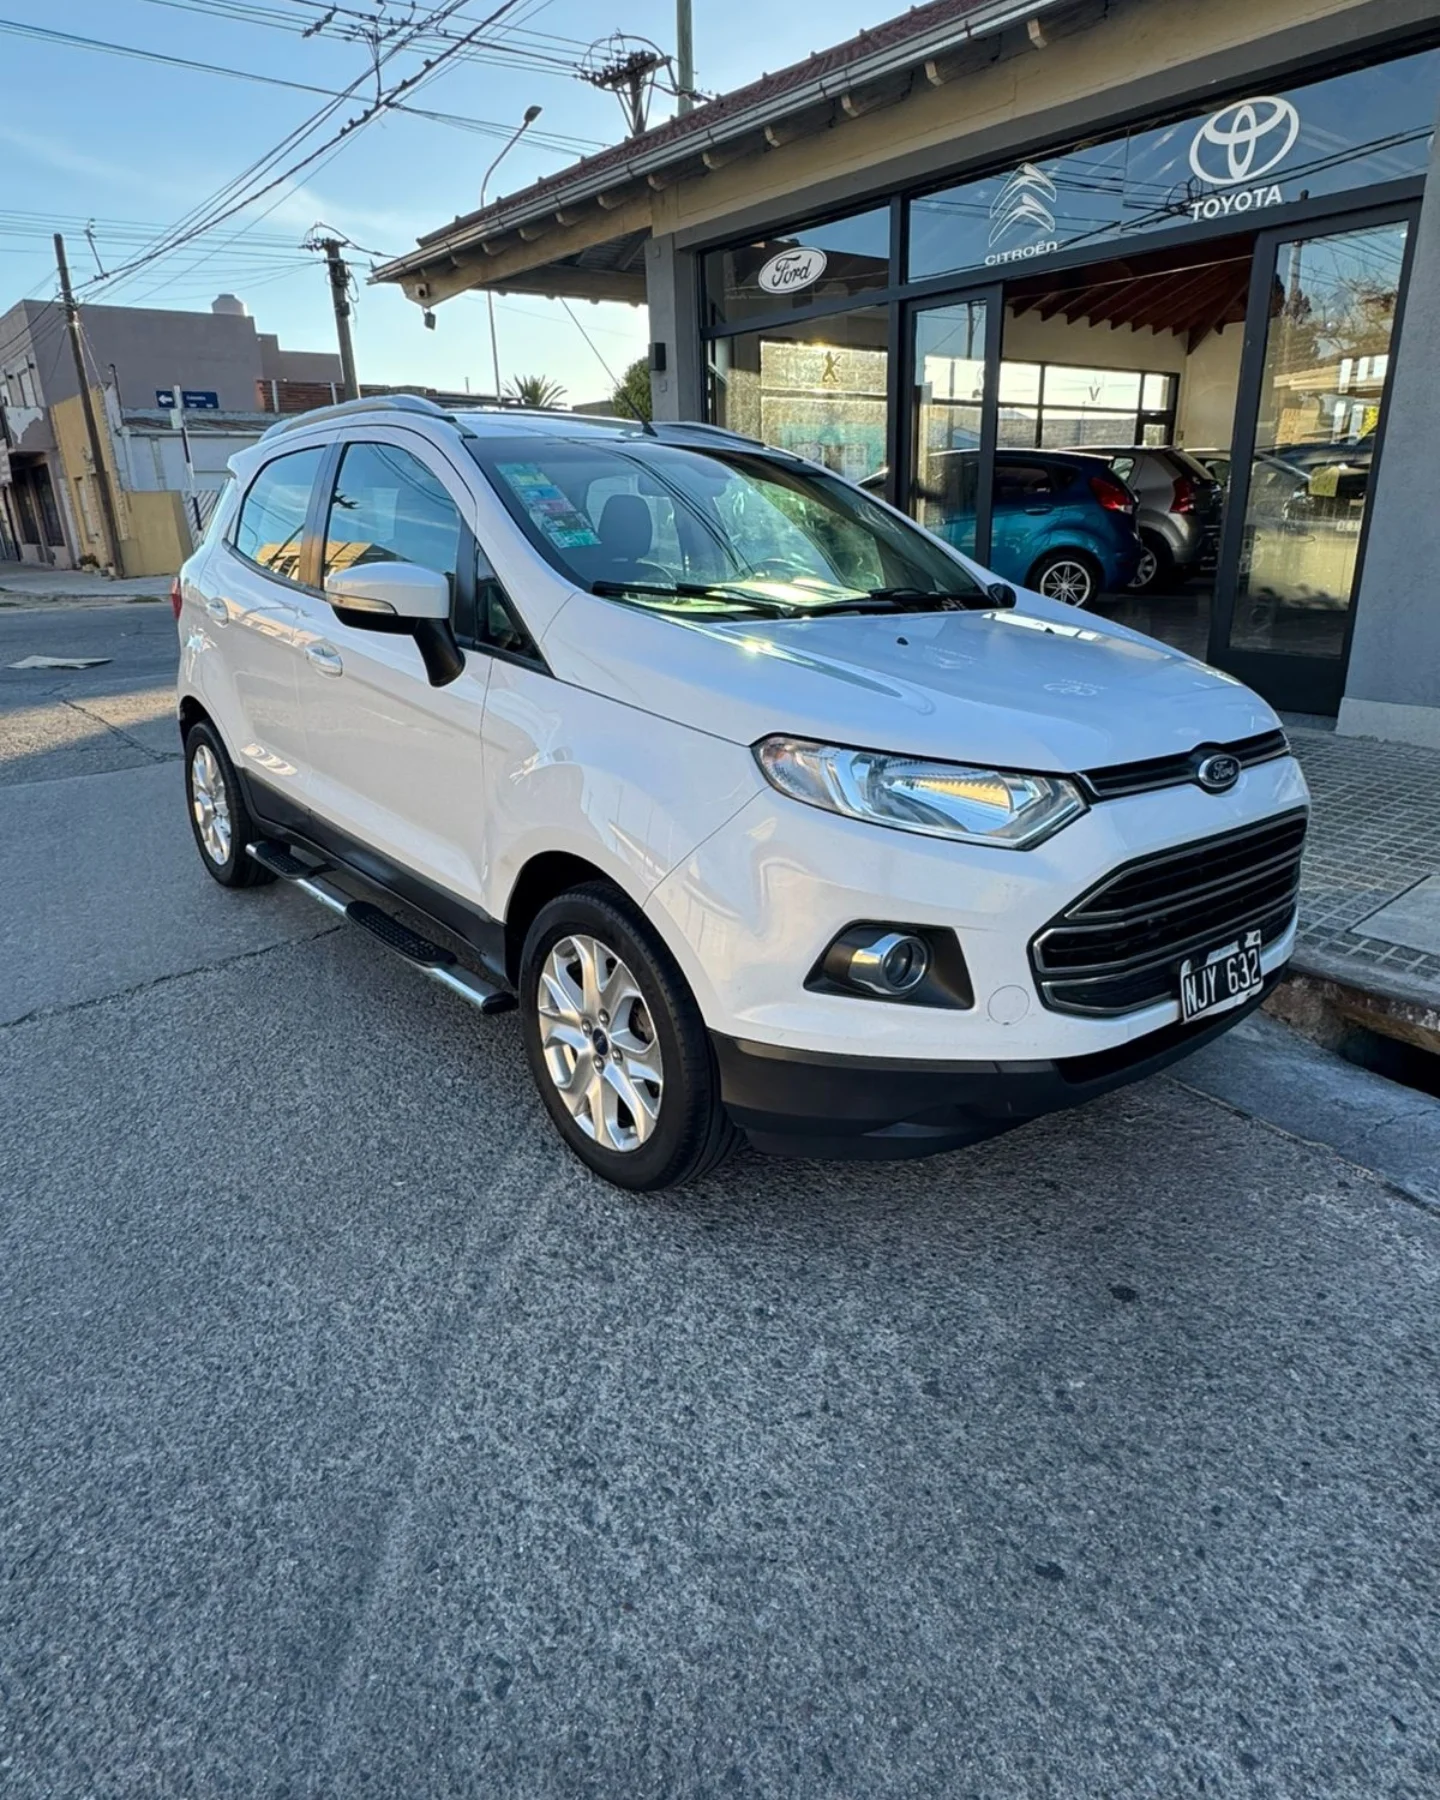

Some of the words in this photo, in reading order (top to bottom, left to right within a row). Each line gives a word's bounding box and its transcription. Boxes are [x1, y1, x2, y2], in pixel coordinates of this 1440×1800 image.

[1189, 184, 1283, 222] TOYOTA
[771, 254, 813, 287] Ford
[1185, 965, 1217, 1015] NJY
[1226, 948, 1260, 994] 632
